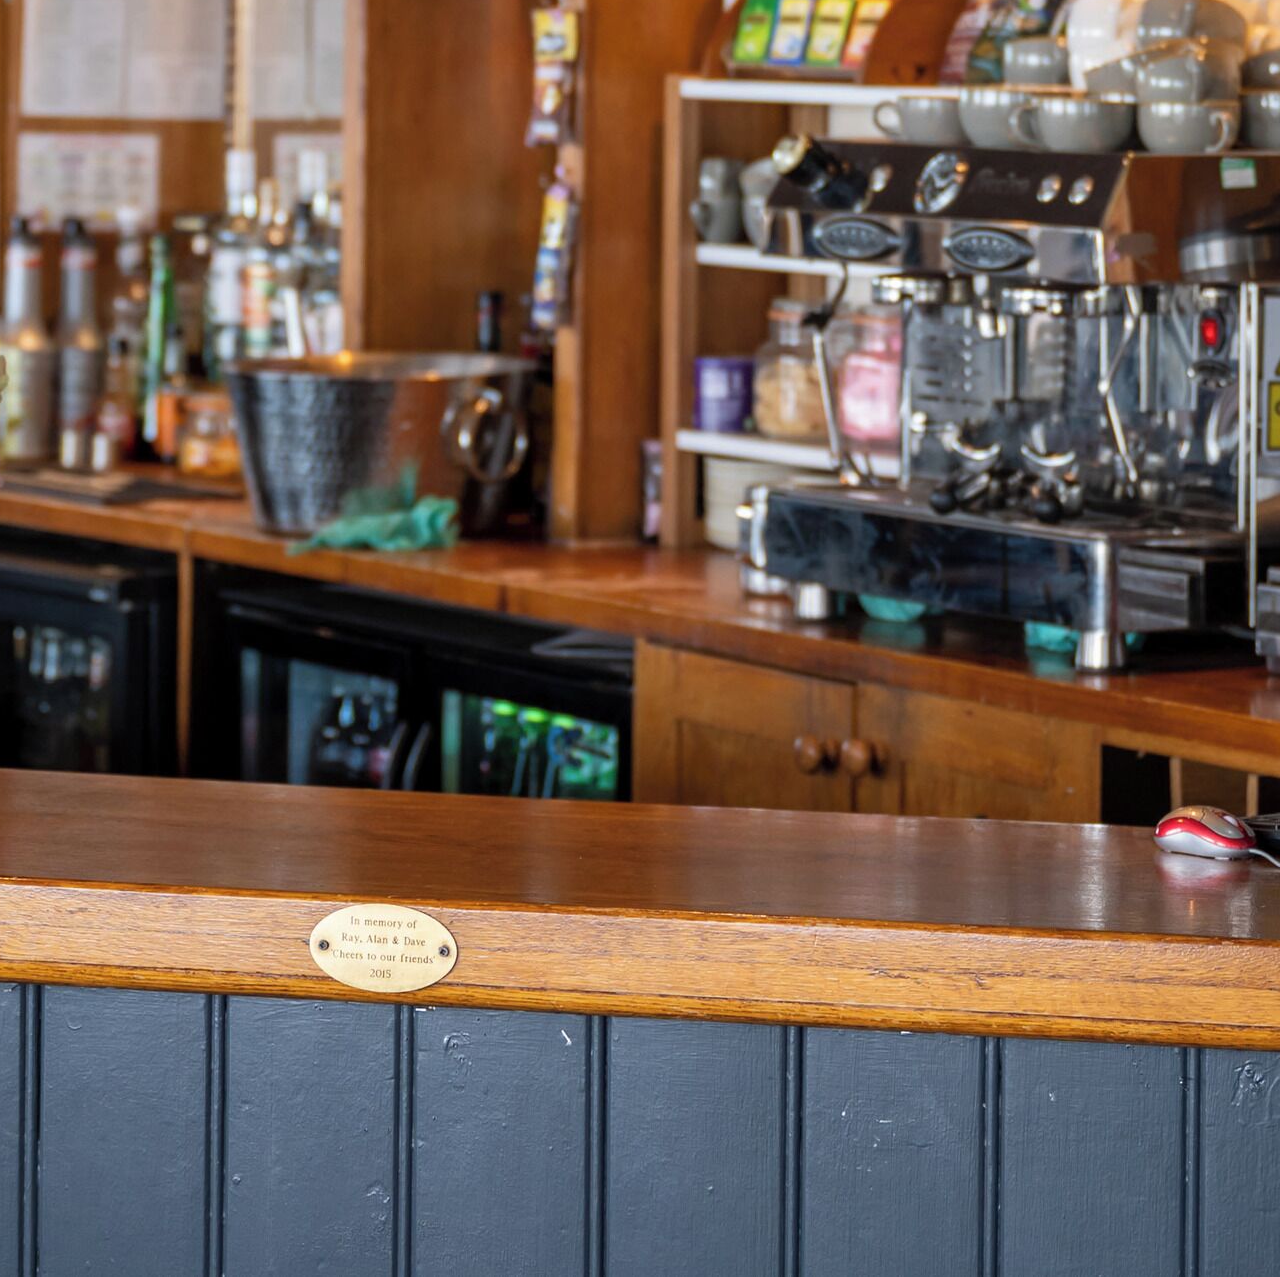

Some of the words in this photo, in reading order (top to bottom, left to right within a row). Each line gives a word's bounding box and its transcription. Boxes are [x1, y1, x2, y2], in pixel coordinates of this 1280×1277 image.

[351, 916, 360, 925] In
[364, 918, 402, 929] memory
[407, 920, 418, 929] of
[366, 934, 388, 945] Alan
[392, 936, 399, 945] &
[404, 936, 426, 947] Dave
[367, 951, 377, 960] to
[380, 954, 396, 962] our
[370, 969, 392, 979] 2015
